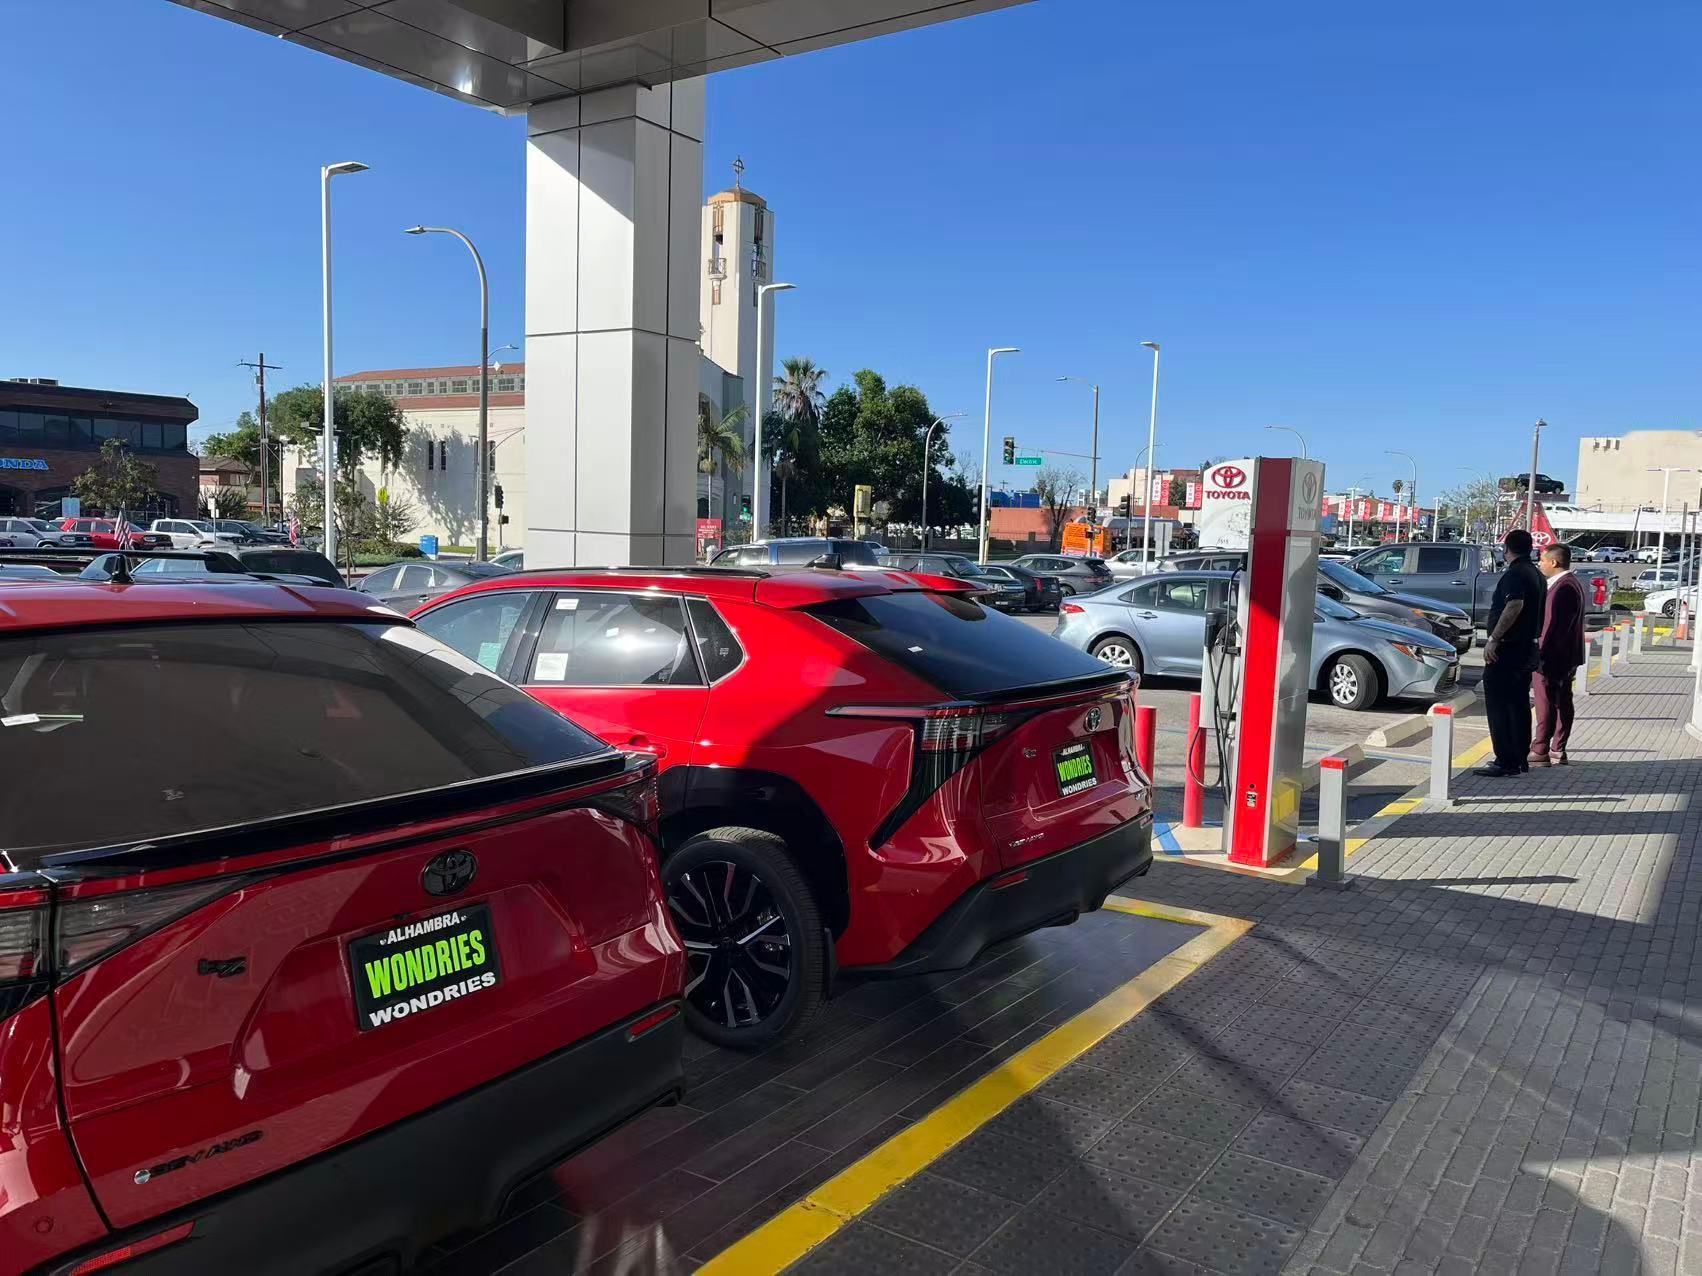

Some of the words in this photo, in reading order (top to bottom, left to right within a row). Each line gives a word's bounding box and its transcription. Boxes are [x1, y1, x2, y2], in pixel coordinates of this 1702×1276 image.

[0, 458, 49, 470] NDA
[1205, 490, 1251, 500] TOYOTA
[1057, 755, 1092, 782] WONDRIES
[1062, 778, 1097, 796] WONDRIES
[387, 912, 460, 945] ALHAMBRA
[365, 930, 486, 999] WONDRIES
[369, 971, 496, 1027] WONDRIES
